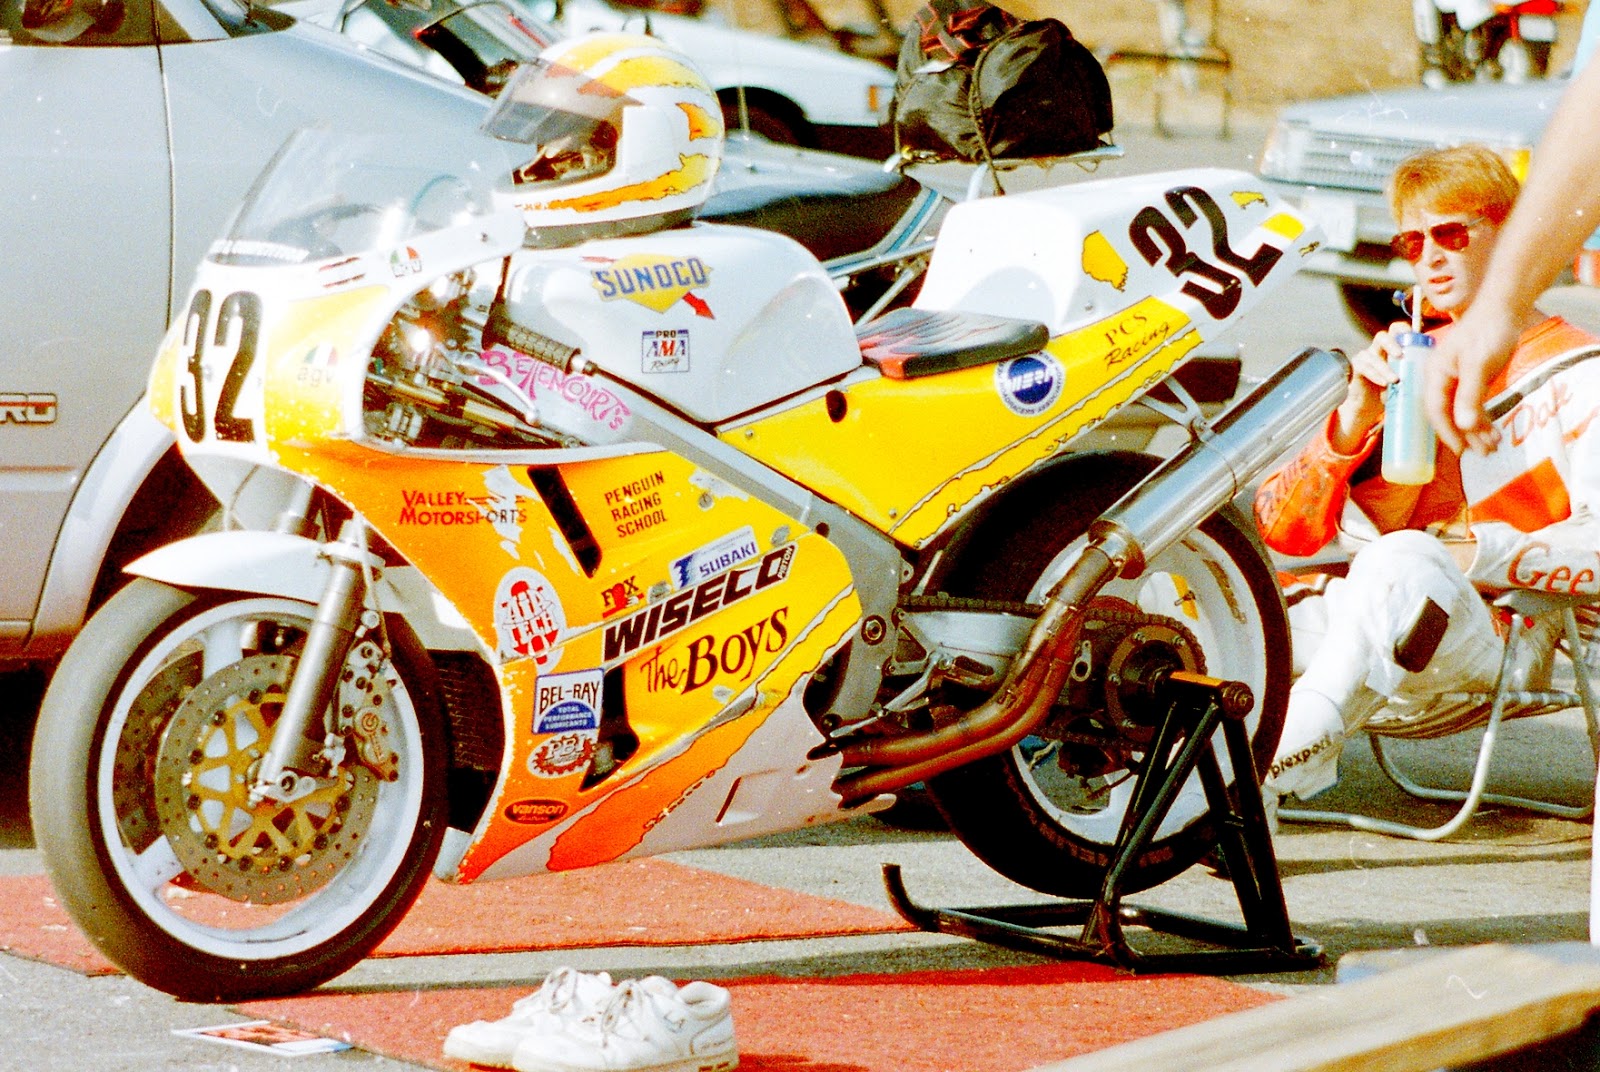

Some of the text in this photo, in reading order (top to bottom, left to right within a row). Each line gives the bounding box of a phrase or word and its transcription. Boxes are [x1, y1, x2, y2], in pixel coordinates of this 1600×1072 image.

[1128, 186, 1283, 320] 32
[595, 257, 707, 297] SUNOCO
[646, 339, 685, 357] AMA
[655, 329, 677, 338] PRO
[179, 288, 263, 443] 32
[401, 490, 465, 507] VALLEY
[604, 471, 664, 505] PENGUIN
[611, 491, 661, 522] RACING
[616, 509, 667, 538] SCHOOL
[603, 544, 796, 661] WISECO
[640, 645, 687, 694] The
[540, 681, 599, 715] BEL-RAY
